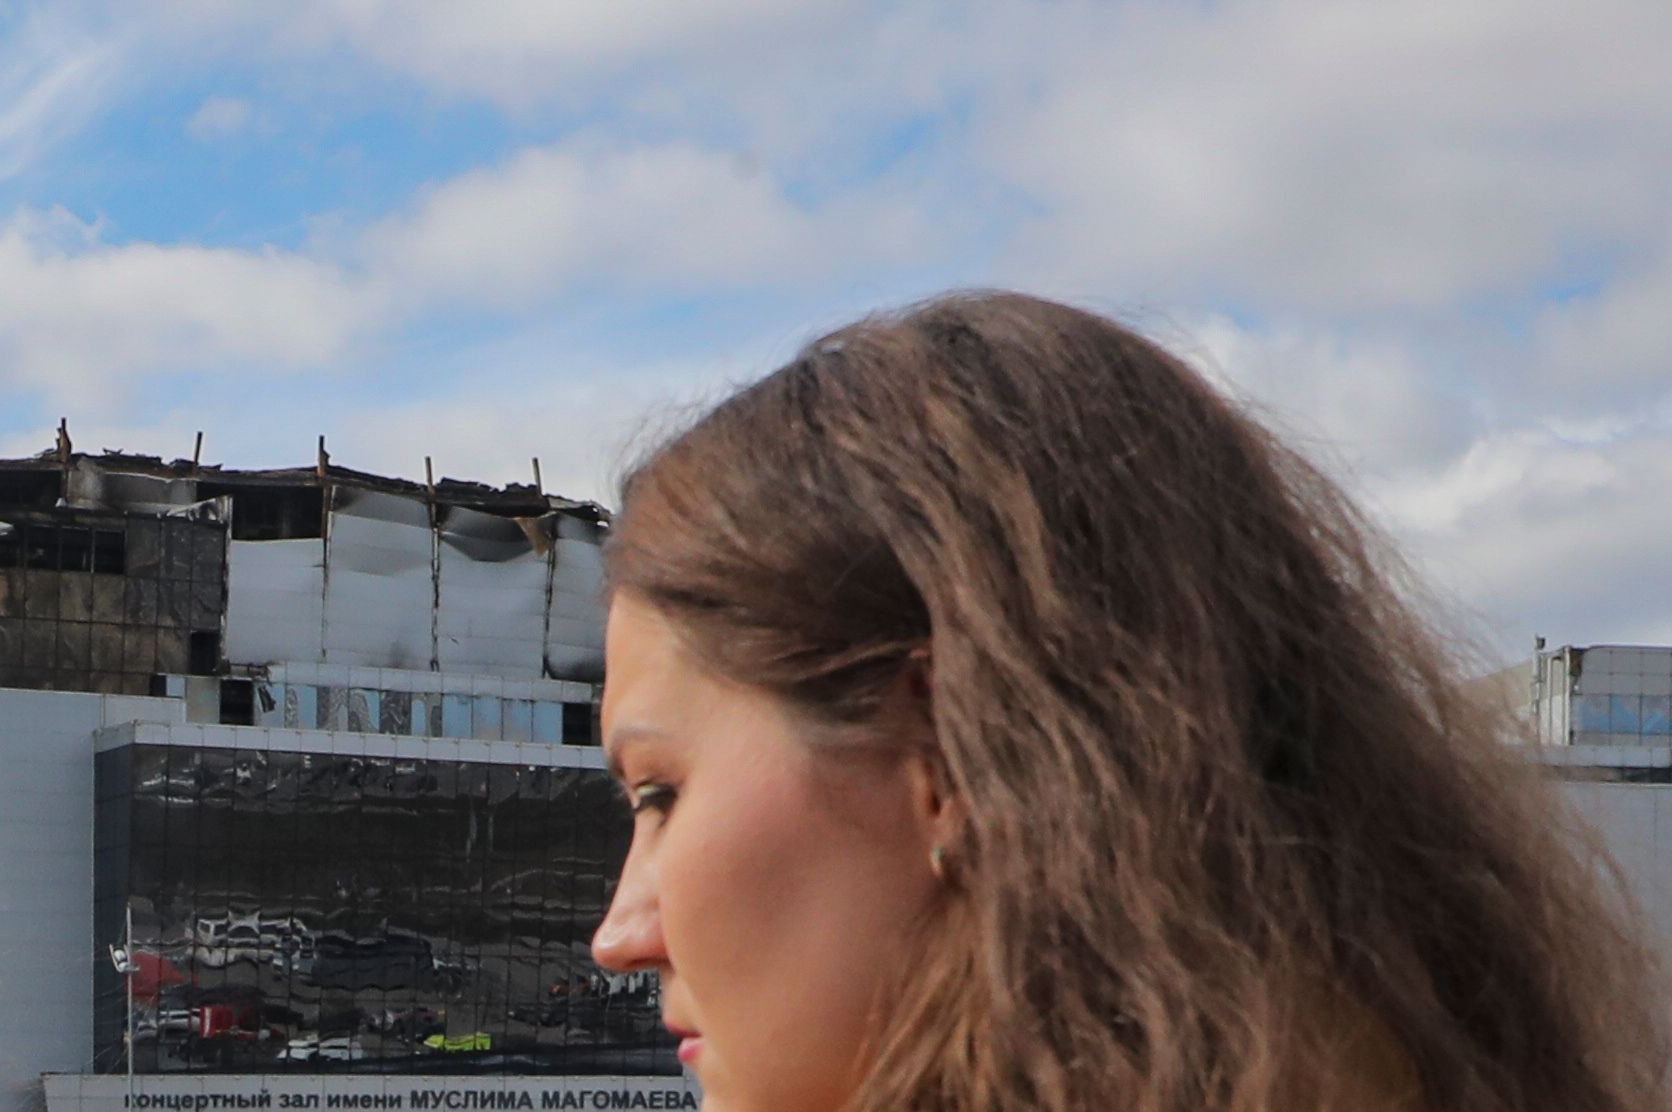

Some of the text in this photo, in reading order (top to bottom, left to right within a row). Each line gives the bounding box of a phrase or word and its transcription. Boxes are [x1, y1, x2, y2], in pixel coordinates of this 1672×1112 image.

[124, 1089, 698, 1112] концертный зал имени МУСЛИМА МАГОМАЕВА
